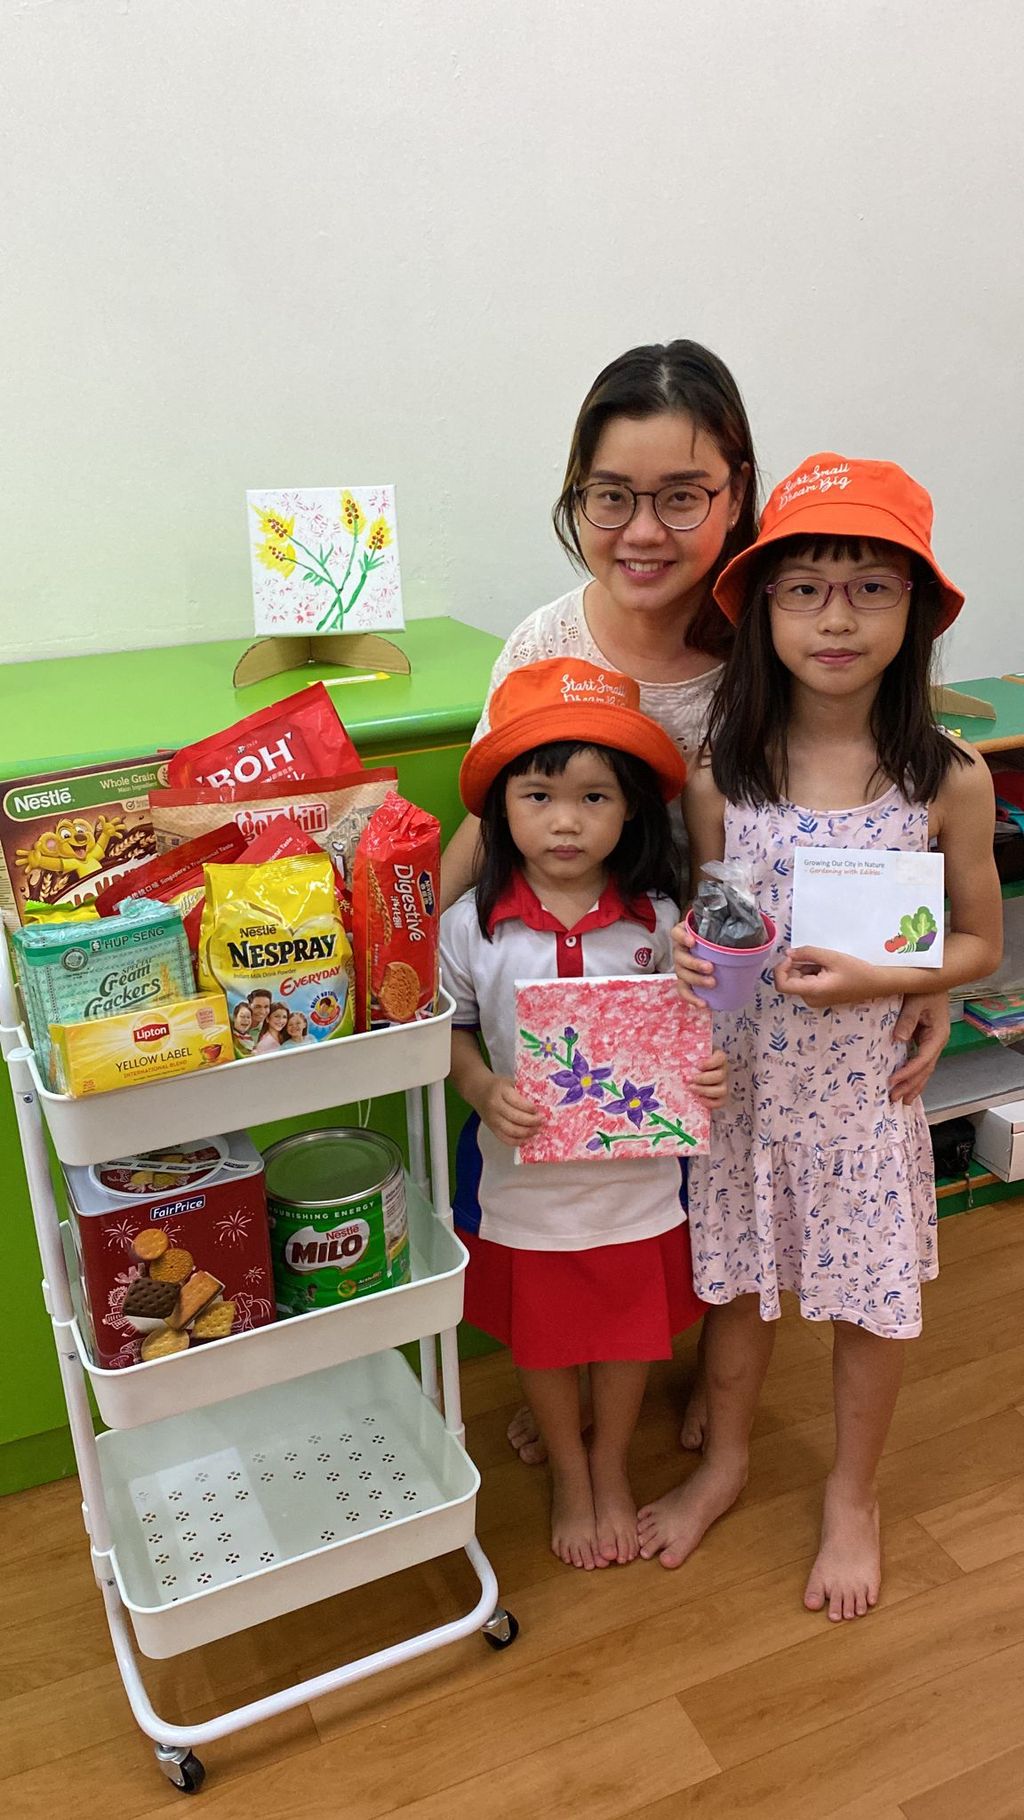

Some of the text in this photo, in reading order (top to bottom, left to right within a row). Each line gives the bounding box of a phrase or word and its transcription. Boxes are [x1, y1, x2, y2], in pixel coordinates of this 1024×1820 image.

[819, 476, 853, 493] Big
[560, 674, 597, 694] Start
[206, 738, 295, 788] BOH
[100, 771, 156, 790] Whole Grain
[14, 787, 72, 813] Nestlé
[804, 859, 831, 868] Growing
[831, 859, 843, 867] Our
[844, 860, 856, 868] City
[393, 864, 426, 942] Digestive
[105, 927, 165, 949] HUP SENG
[240, 924, 277, 938] Nestlé
[227, 933, 337, 969] NESPRAY
[99, 964, 151, 997] Cream
[280, 966, 341, 997] EVERYDAY
[84, 978, 161, 1018] Crackers
[136, 1026, 168, 1040] Lipton
[116, 1047, 193, 1072] YELLOW LABEL
[123, 1065, 168, 1079] INTERNATIONAL
[169, 1060, 187, 1069] BLEND
[153, 1199, 203, 1219] FairPrice
[334, 1201, 375, 1218] ENERGY
[325, 1223, 360, 1241] Nestlé
[291, 1234, 363, 1264] MILO
